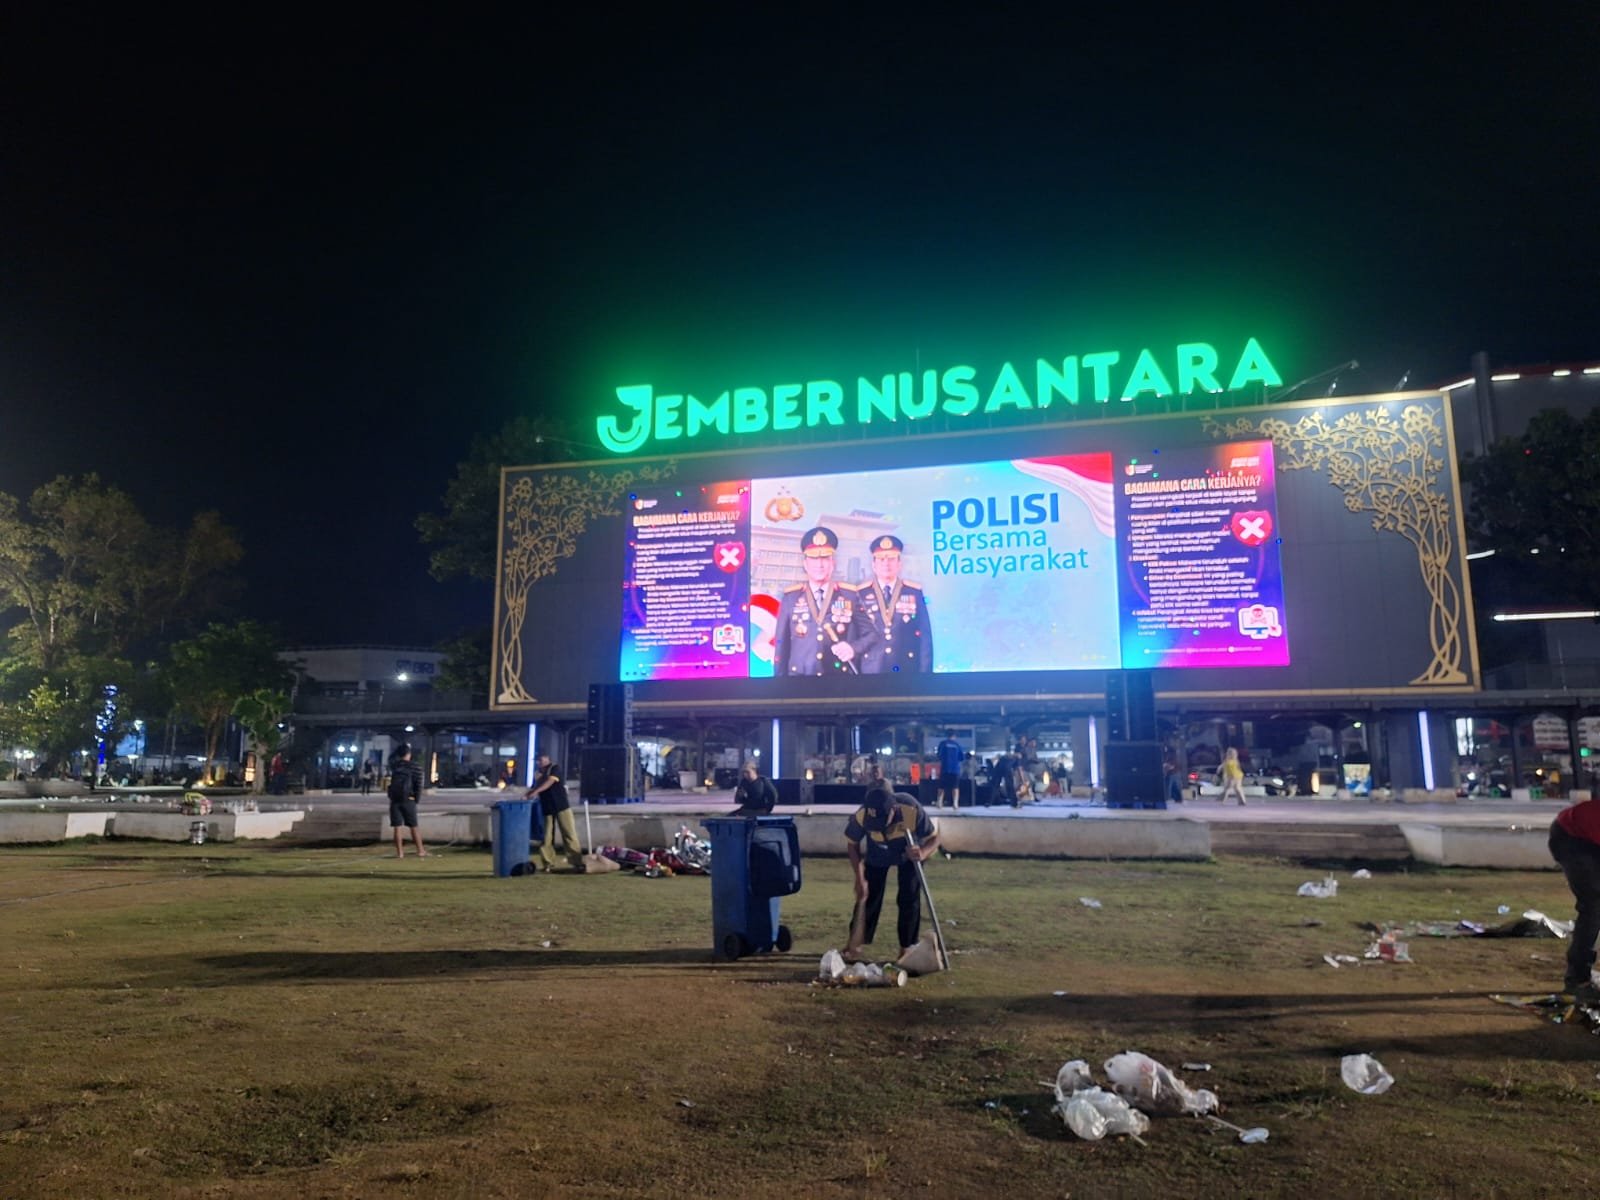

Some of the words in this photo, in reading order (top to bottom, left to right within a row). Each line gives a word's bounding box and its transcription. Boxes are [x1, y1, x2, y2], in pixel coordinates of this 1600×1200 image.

[597, 380, 844, 453] JEMBER
[857, 337, 1282, 423] NUSANTARA
[1125, 480, 1181, 495] BAGAIMANA
[1180, 478, 1206, 491] CARA
[1207, 475, 1261, 489] KERJANYA?
[932, 493, 1059, 529] POLISI
[933, 529, 1046, 552] Bersama
[933, 547, 1089, 578] Masyarakat
